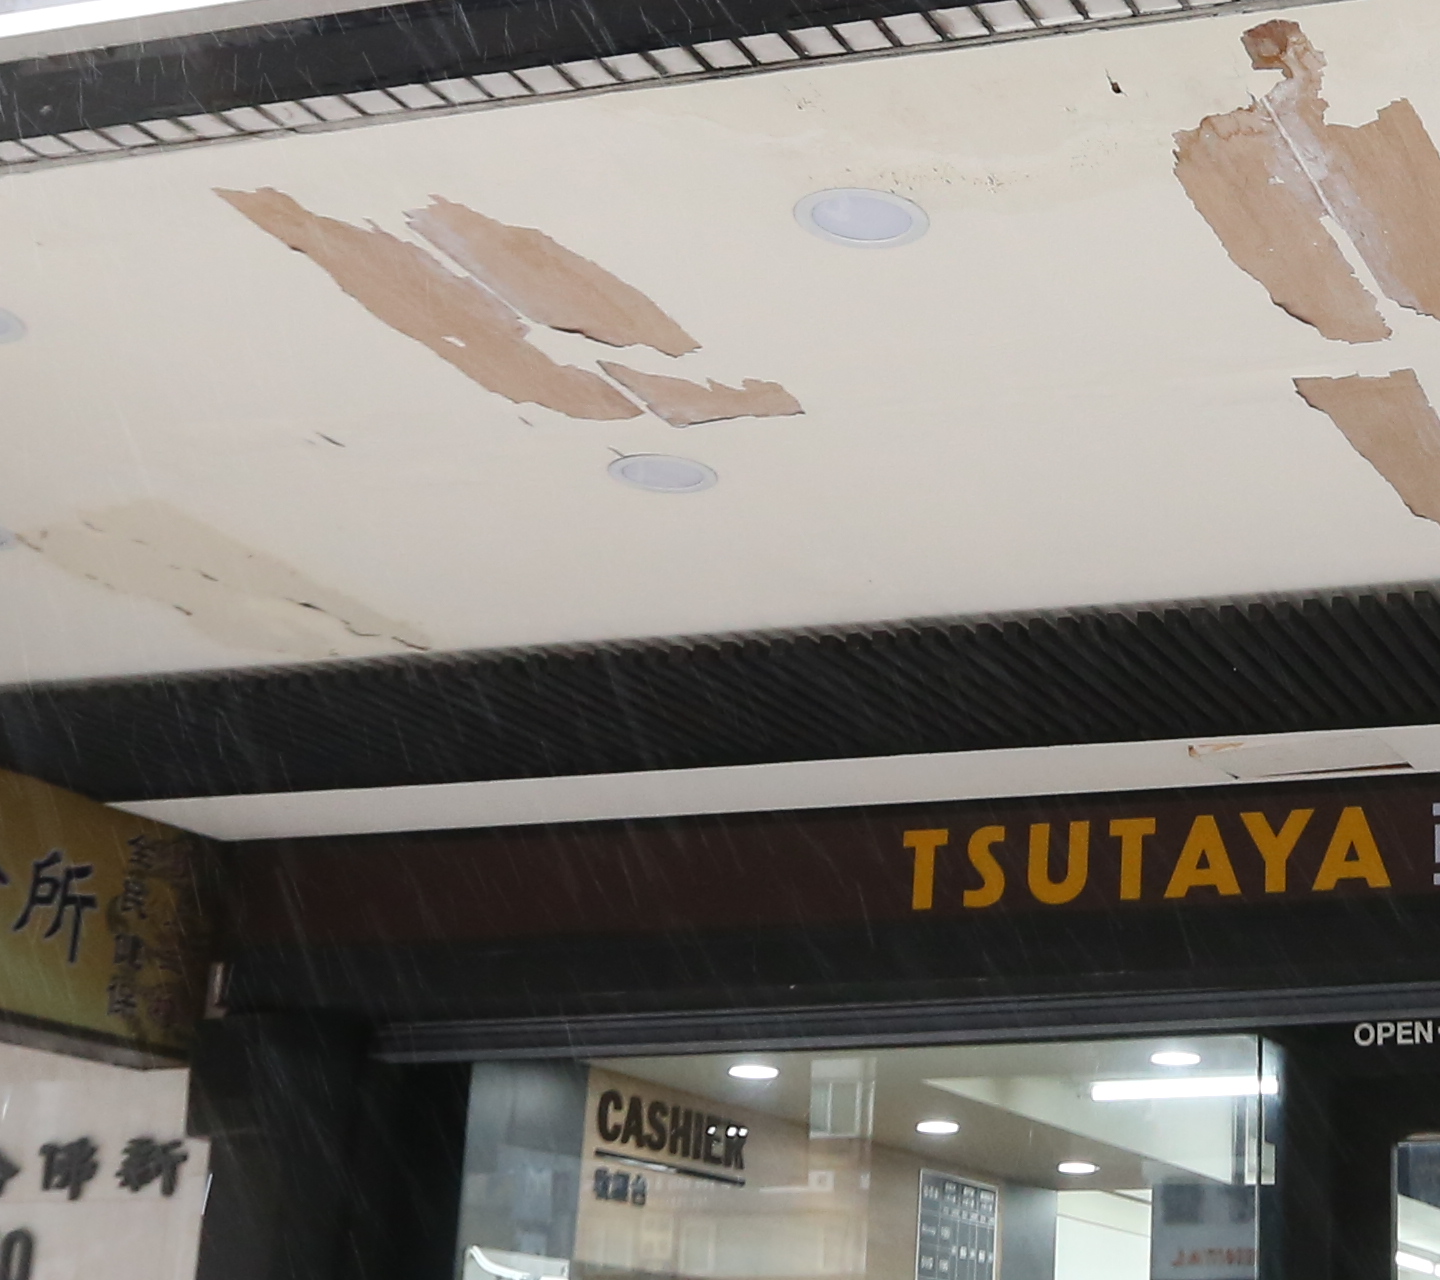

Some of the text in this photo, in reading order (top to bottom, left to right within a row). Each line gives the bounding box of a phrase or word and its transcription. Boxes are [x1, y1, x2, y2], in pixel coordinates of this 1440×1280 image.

[902, 806, 1392, 910] TSUTAYA
[1353, 1021, 1434, 1048] OPEN
[596, 1089, 748, 1169] CASHIER
